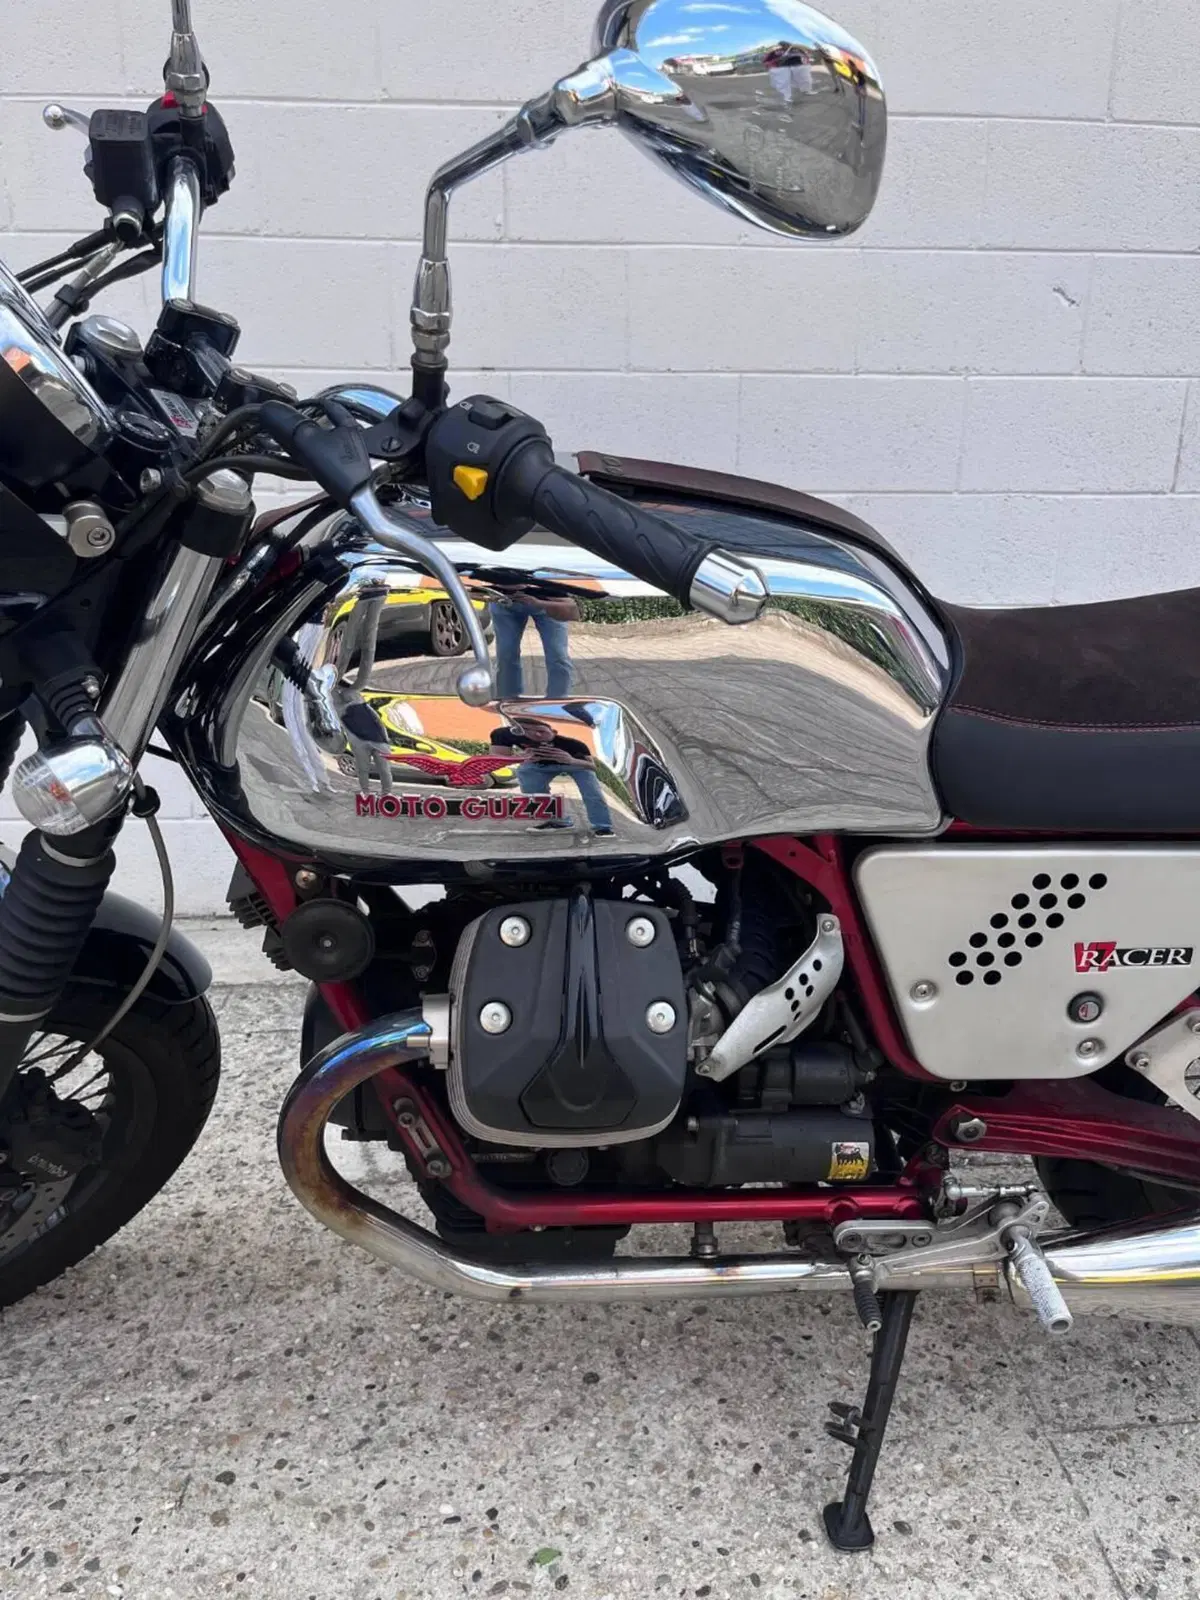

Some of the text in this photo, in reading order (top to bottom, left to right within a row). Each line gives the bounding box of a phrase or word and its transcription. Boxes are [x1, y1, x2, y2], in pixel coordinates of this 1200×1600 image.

[355, 793, 565, 820] MOTO GUZZI
[1079, 948, 1187, 967] RACER
